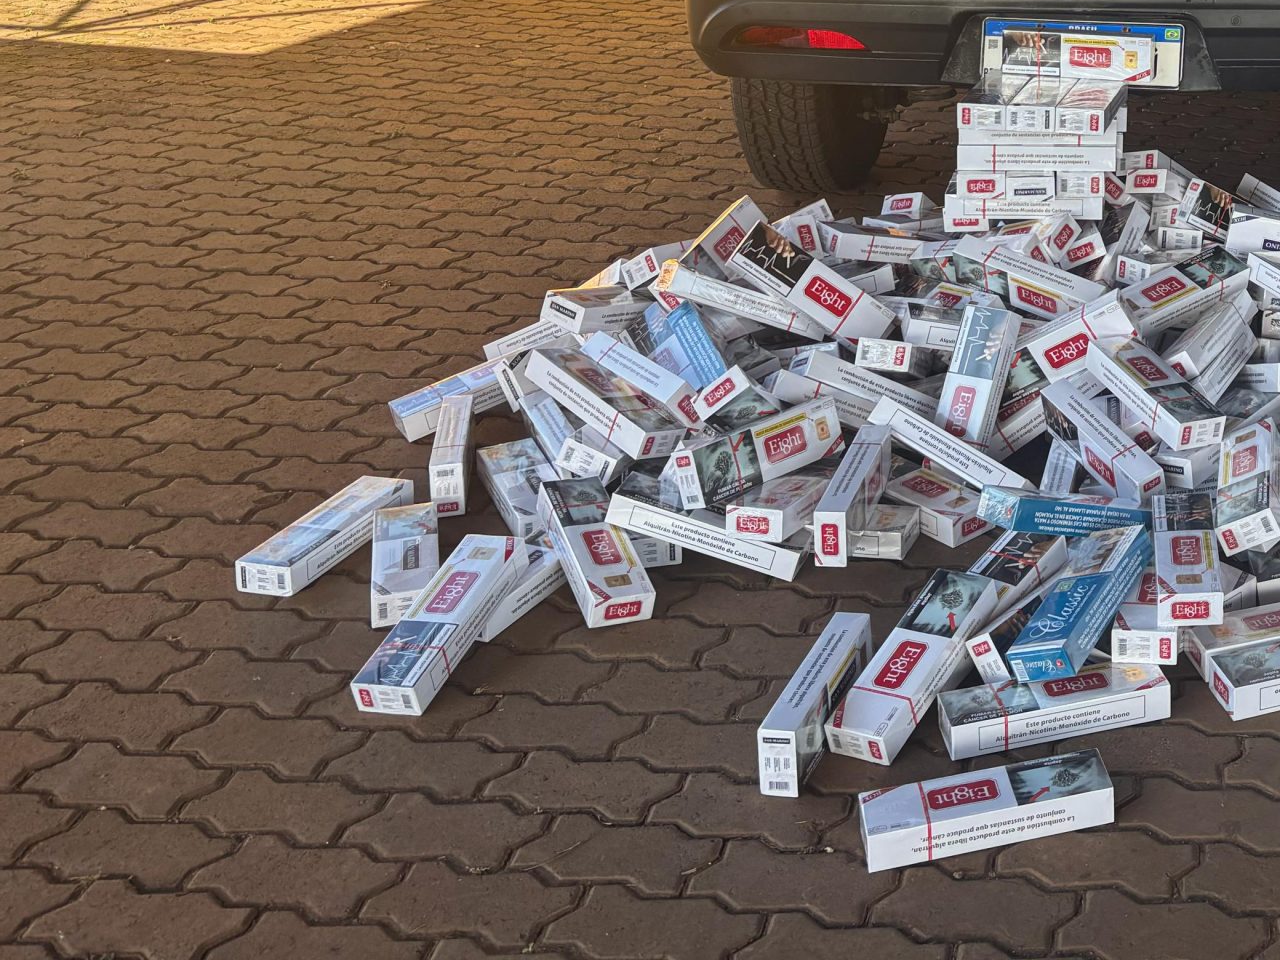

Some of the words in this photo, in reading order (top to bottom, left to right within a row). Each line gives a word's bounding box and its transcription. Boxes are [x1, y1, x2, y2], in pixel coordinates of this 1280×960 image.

[1073, 49, 1108, 66] Eight
[1136, 177, 1156, 186] Eight
[717, 229, 743, 256] Eight
[1056, 225, 1072, 248] Eight
[1069, 244, 1093, 259] Eight
[811, 279, 848, 311] Eight
[1150, 278, 1181, 298] Eight
[1021, 291, 1054, 309] Eight
[1048, 337, 1088, 363] Eight
[1131, 359, 1161, 380] Eight
[842, 376, 860, 387] conjunto
[844, 370, 869, 382] combustión
[885, 386, 904, 397] producto
[551, 374, 569, 390] combustión
[581, 397, 596, 410] producto
[707, 381, 731, 404] Eight
[952, 392, 973, 432] Eight
[904, 419, 923, 432] Carbono
[768, 431, 802, 456] Eight
[920, 436, 939, 449] contiene
[677, 458, 690, 466] Eight
[940, 449, 959, 462] producto
[1236, 449, 1256, 474] Eight
[959, 461, 969, 470] Este
[911, 477, 943, 495] Eight
[738, 517, 769, 531] Eight
[672, 522, 683, 530] Este
[684, 527, 710, 539] producto
[711, 535, 735, 547] contiene
[825, 527, 835, 553] Eight
[592, 533, 615, 562] Eight
[735, 550, 758, 562] Carbono
[1180, 538, 1195, 563] Eight
[432, 575, 470, 609] Eight
[609, 602, 638, 616] Eight
[1029, 583, 1089, 638] Classic
[1174, 602, 1208, 617] Eight
[883, 645, 922, 683] Eight
[1051, 675, 1102, 693] Eight
[1026, 720, 1040, 728] Este
[1041, 715, 1071, 727] producto
[1073, 709, 1101, 720] contiene
[1102, 711, 1130, 721] Carbono
[935, 782, 990, 805] Eight
[1034, 809, 1066, 820] conjunto
[947, 827, 974, 837] produce
[976, 824, 989, 832] que
[1027, 817, 1065, 831] combustión
[947, 838, 967, 846] libera
[969, 830, 999, 841] producto
